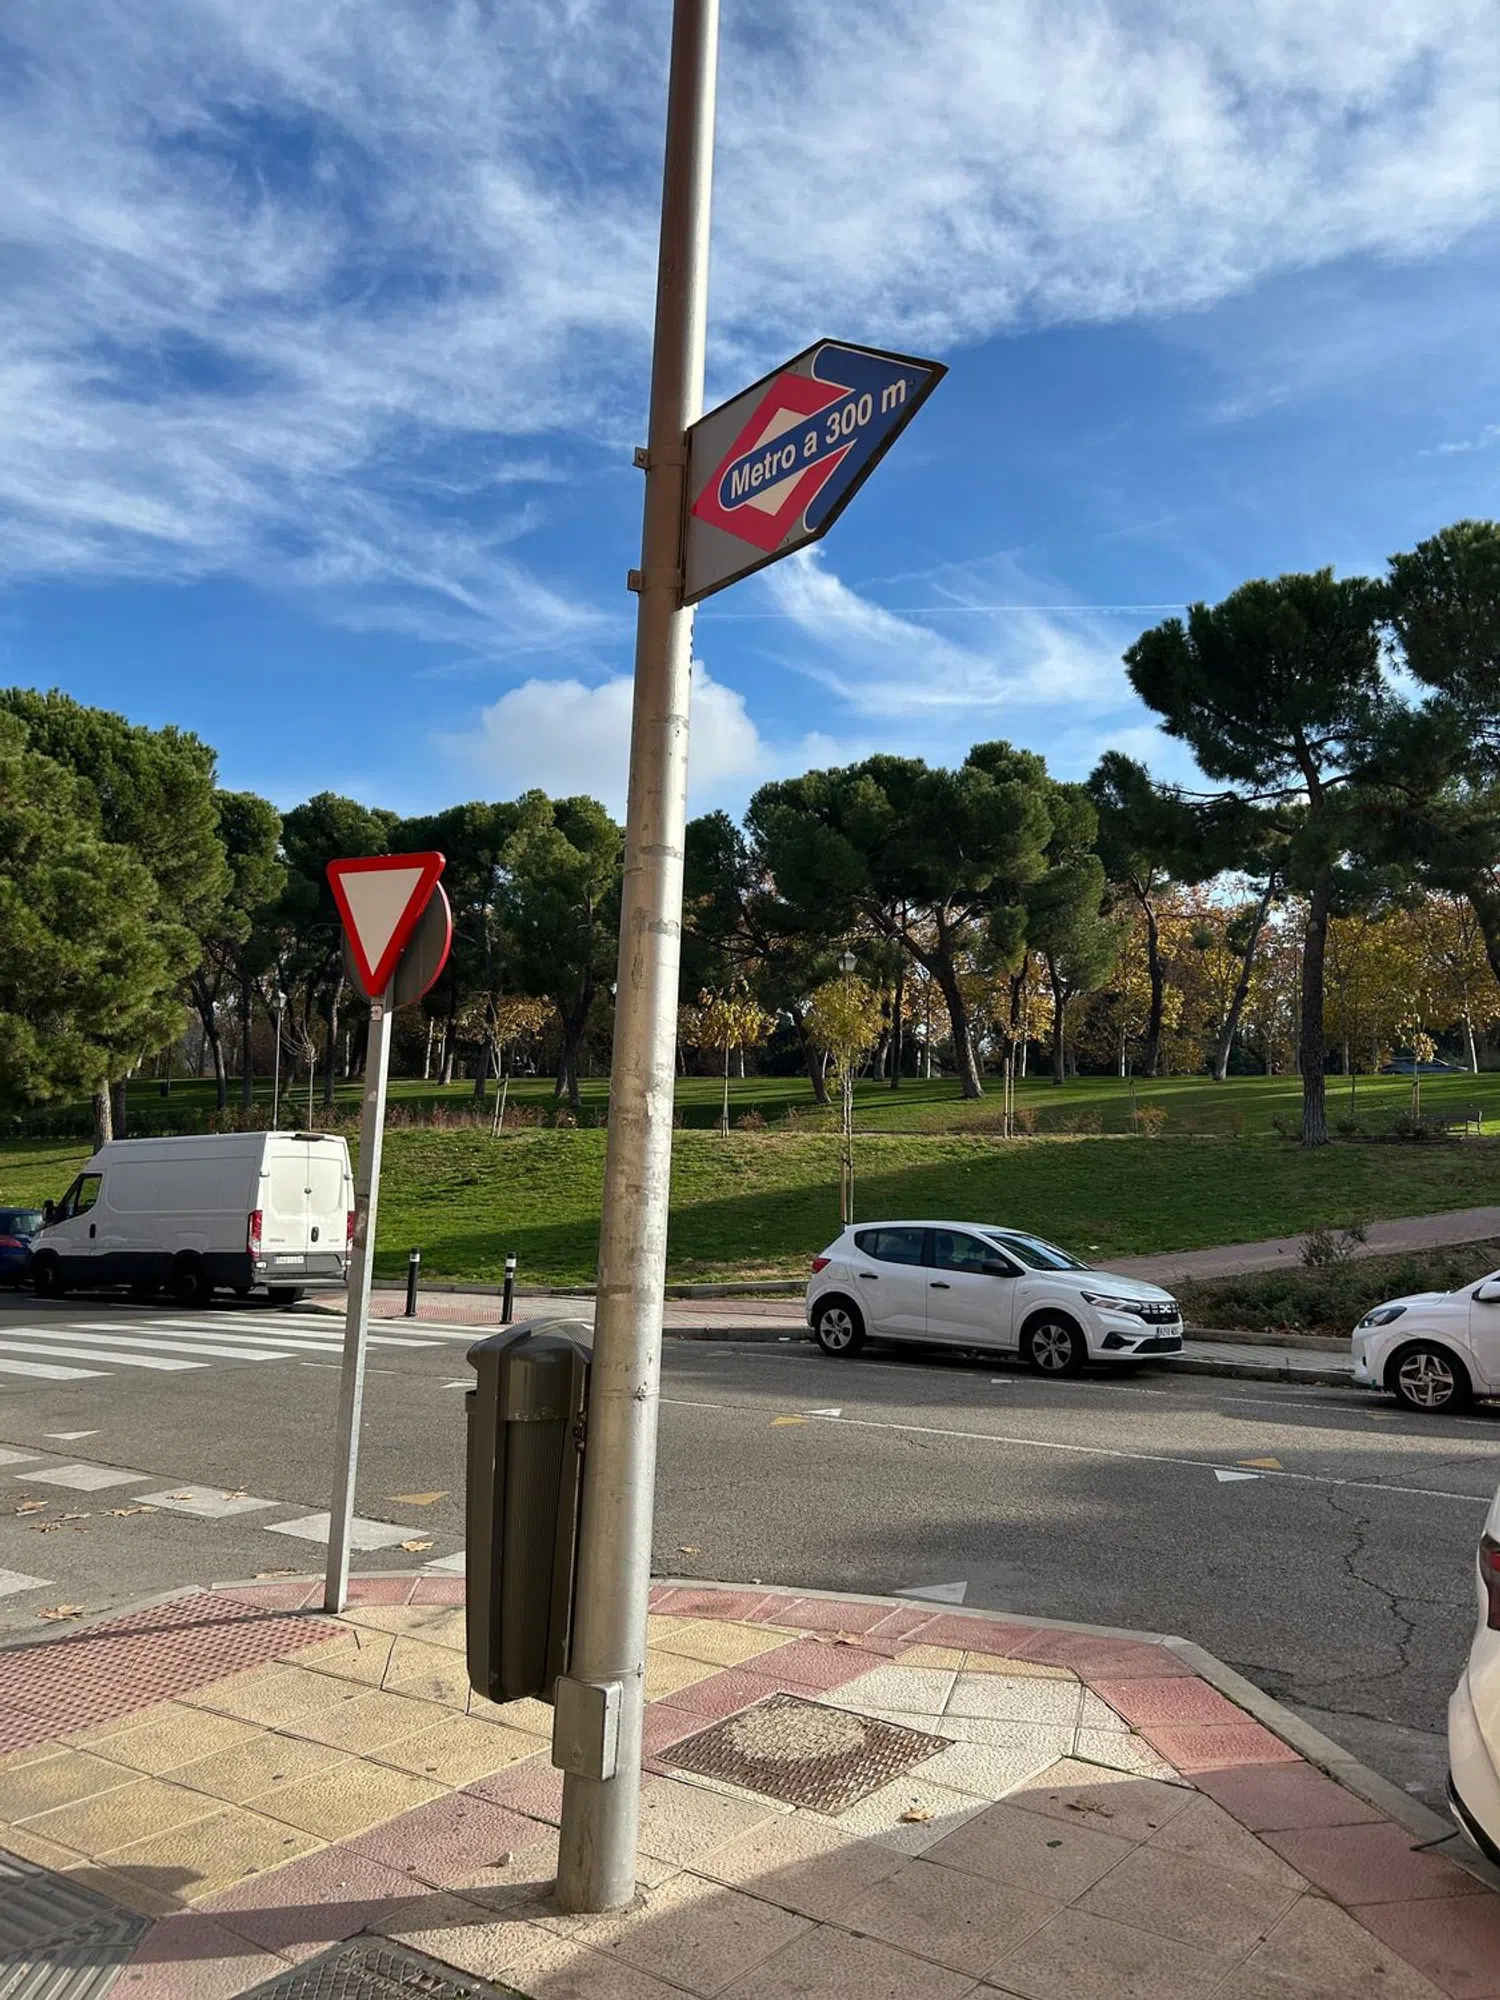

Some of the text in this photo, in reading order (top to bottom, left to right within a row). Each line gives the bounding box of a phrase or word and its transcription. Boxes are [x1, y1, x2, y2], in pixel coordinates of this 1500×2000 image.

[731, 379, 906, 498] Metro a 300 m
